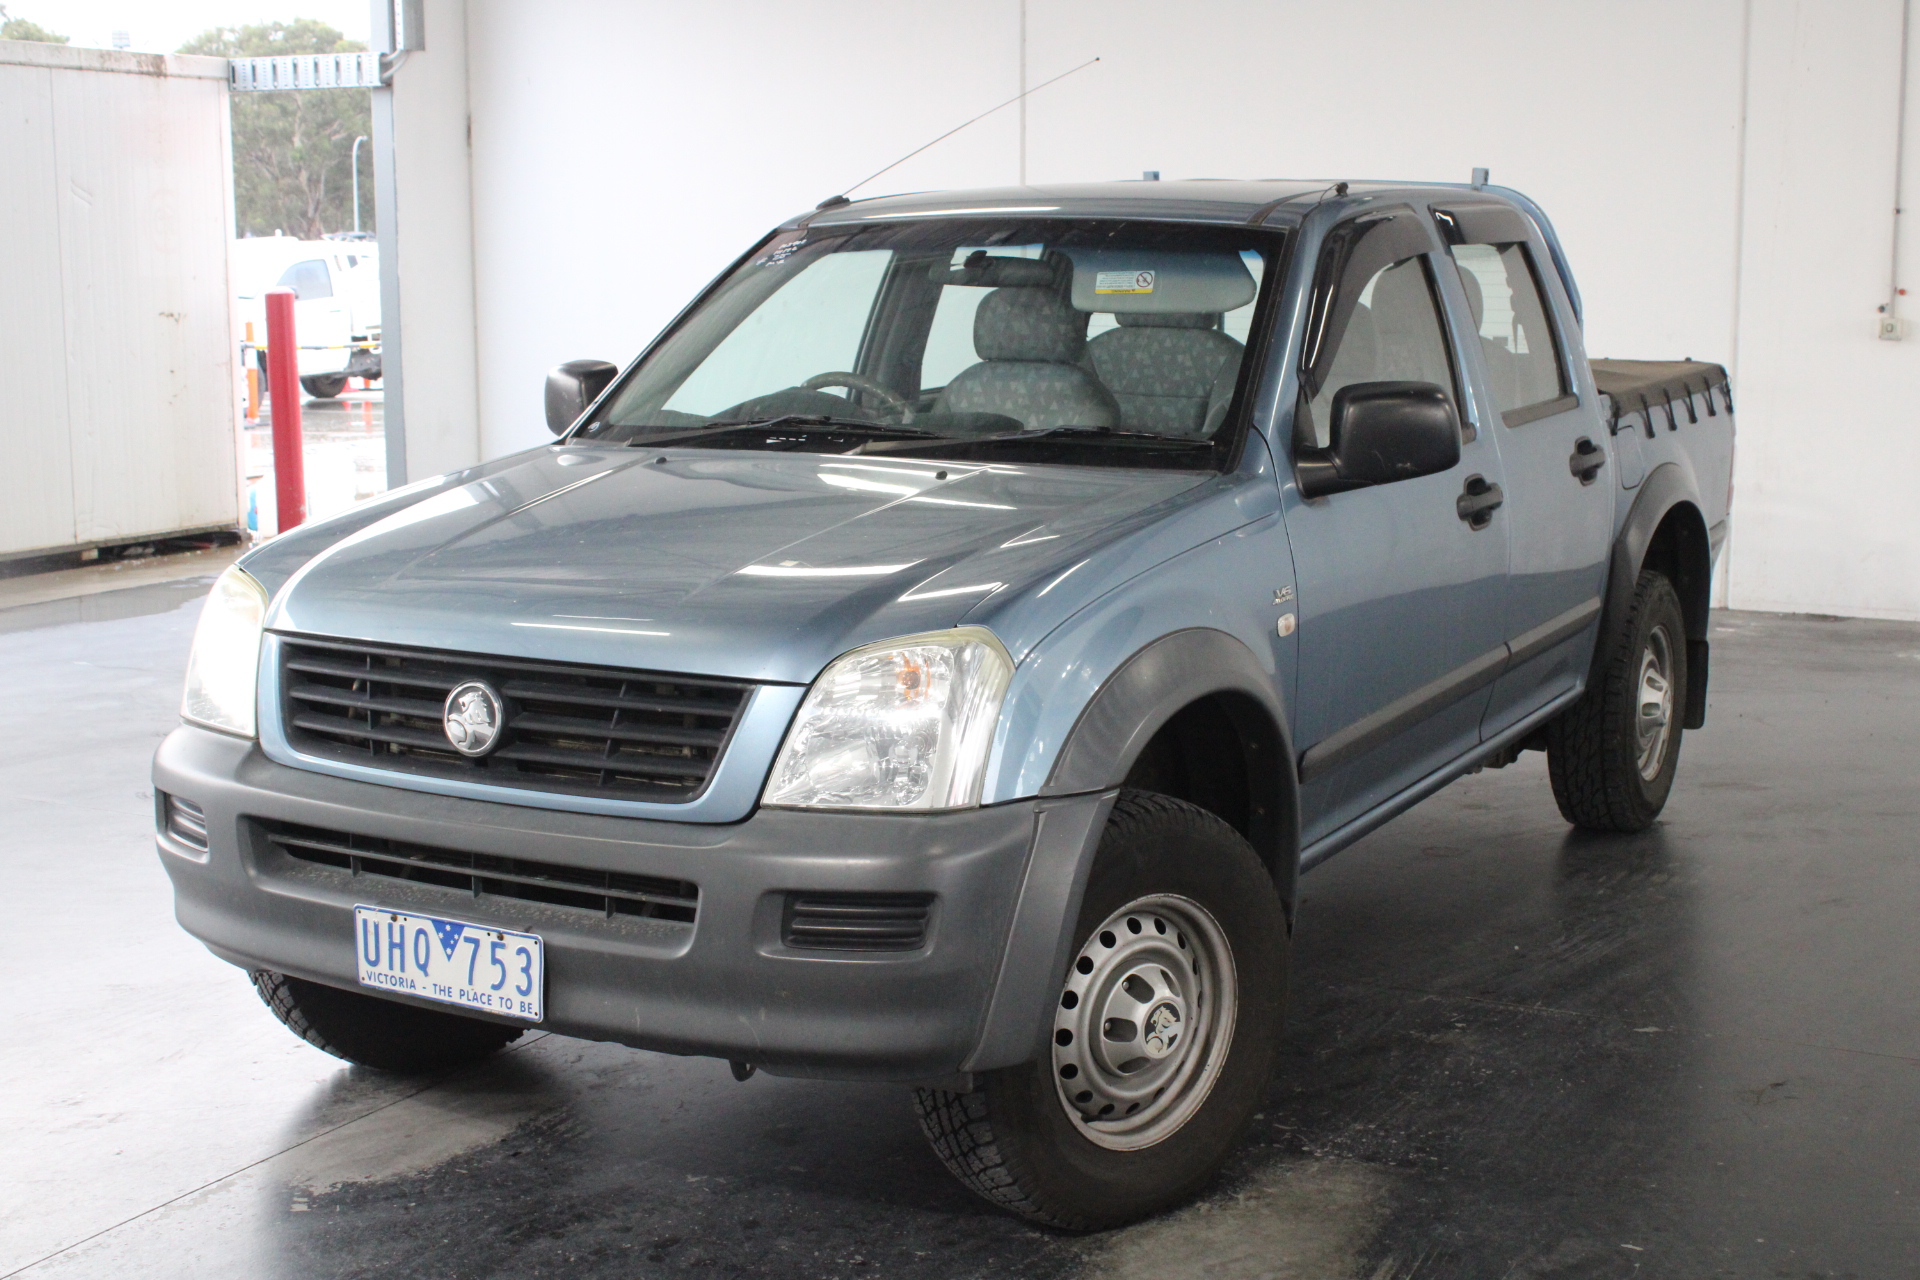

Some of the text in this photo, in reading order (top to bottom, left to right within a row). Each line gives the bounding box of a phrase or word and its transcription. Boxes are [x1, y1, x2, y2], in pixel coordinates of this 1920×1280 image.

[1273, 585, 1291, 597] V6
[362, 918, 533, 997] UHQ 753
[366, 970, 417, 990] VICTORIA
[432, 983, 453, 998] THE
[459, 989, 493, 1006] PLACE
[498, 996, 513, 1010] TO
[519, 1001, 533, 1015] BE
